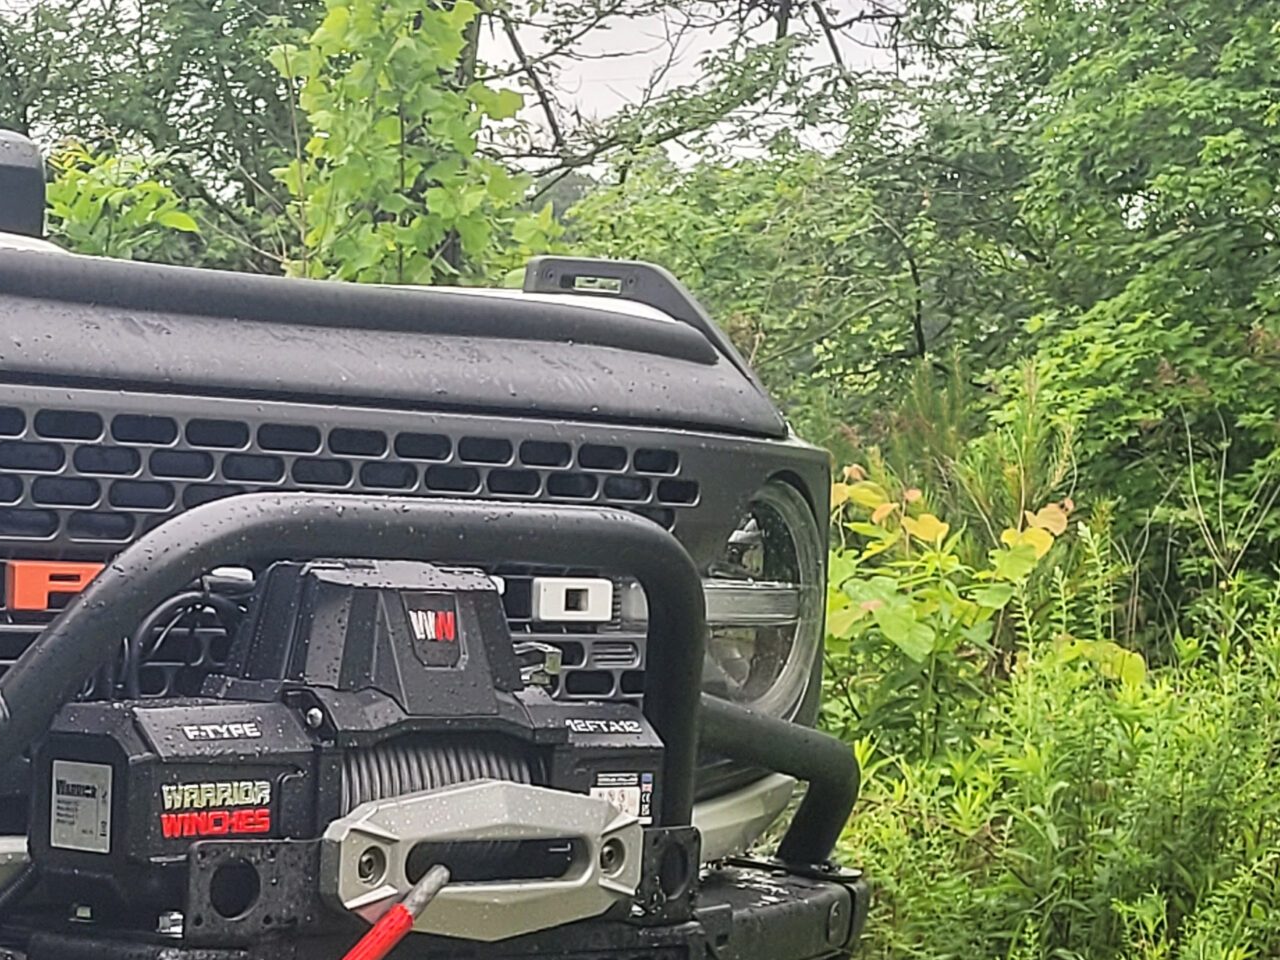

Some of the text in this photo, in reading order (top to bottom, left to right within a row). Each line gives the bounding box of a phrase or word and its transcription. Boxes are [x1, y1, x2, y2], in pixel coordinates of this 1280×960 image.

[183, 722, 262, 740] F-TYPE
[161, 780, 271, 810] WARRIOR
[160, 808, 270, 838] WINCHES
